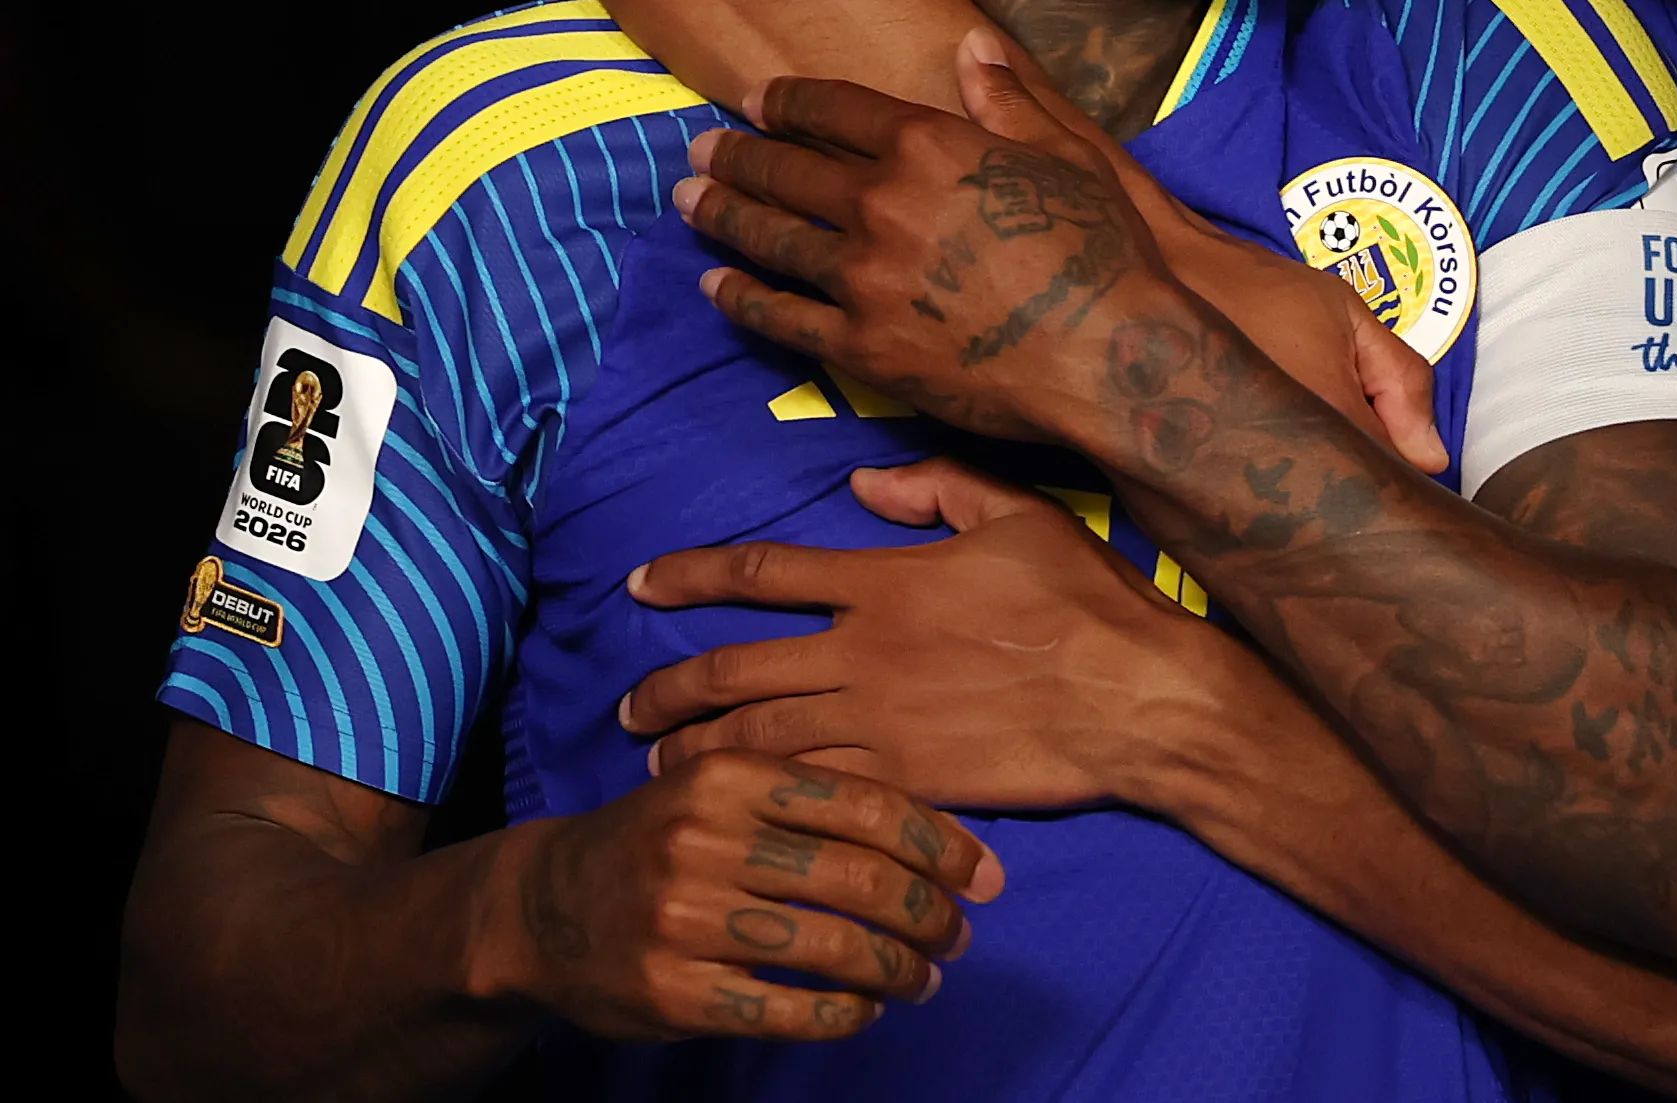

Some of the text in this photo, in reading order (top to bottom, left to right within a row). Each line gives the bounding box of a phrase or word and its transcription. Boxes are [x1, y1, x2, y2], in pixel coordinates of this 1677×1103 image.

[1303, 169, 1457, 316] Futbòl Kòrsou
[266, 465, 301, 491] FIFA
[241, 492, 312, 528] WORLD CUP
[233, 509, 307, 552] 2026
[211, 590, 274, 624] DEBUT
